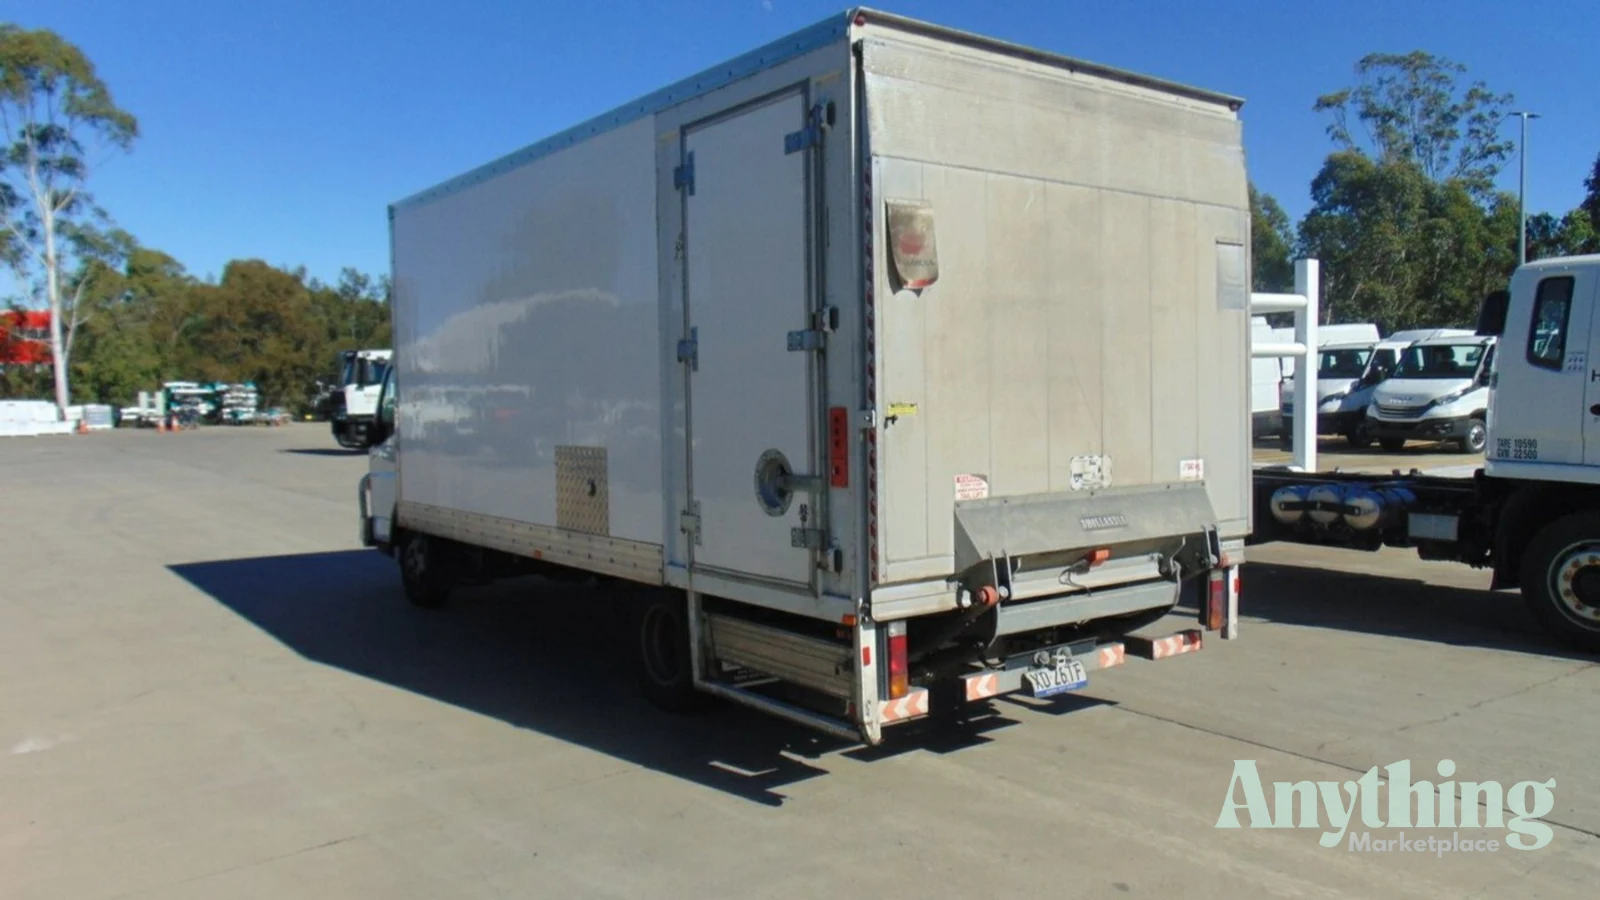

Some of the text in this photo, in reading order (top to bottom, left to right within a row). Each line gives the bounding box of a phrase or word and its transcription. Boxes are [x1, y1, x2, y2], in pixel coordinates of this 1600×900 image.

[1497, 438, 1537, 450] TARE 10590
[1514, 450, 1537, 461] 22500
